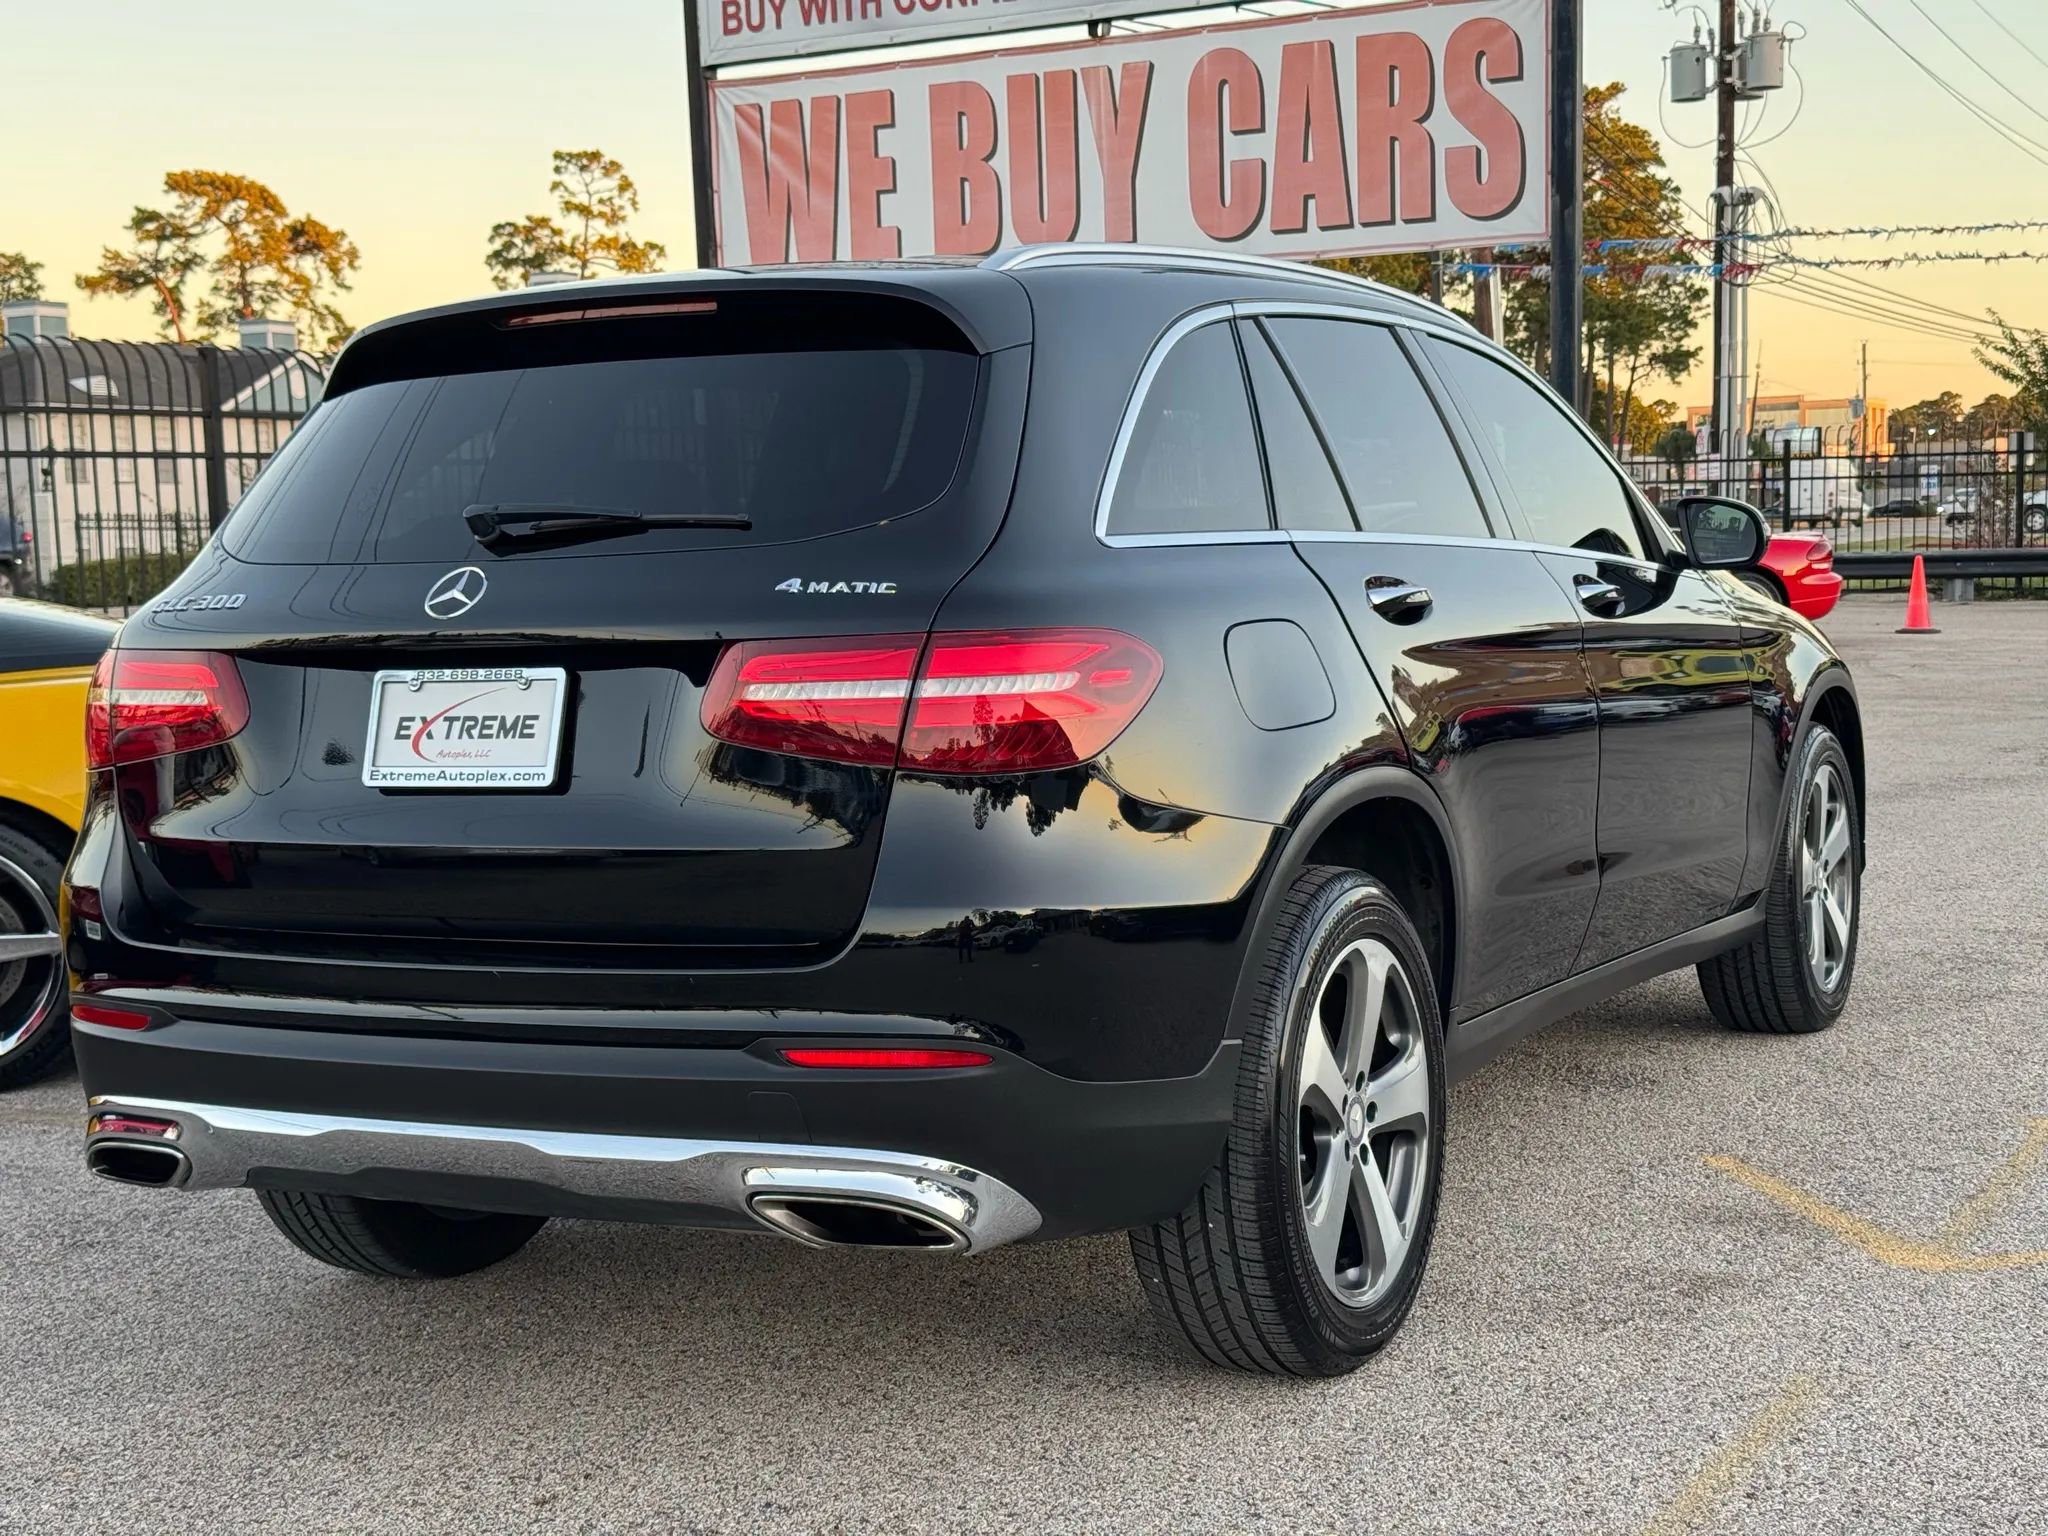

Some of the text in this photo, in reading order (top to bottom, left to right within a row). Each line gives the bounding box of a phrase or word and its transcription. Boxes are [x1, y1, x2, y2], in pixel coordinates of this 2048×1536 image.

[721, 0, 784, 36] BUY
[733, 16, 1526, 265] WE BUY CARS
[193, 594, 248, 611] 300
[394, 714, 541, 741] EXTREME
[369, 769, 546, 784] ExtremeAutoplex.com
